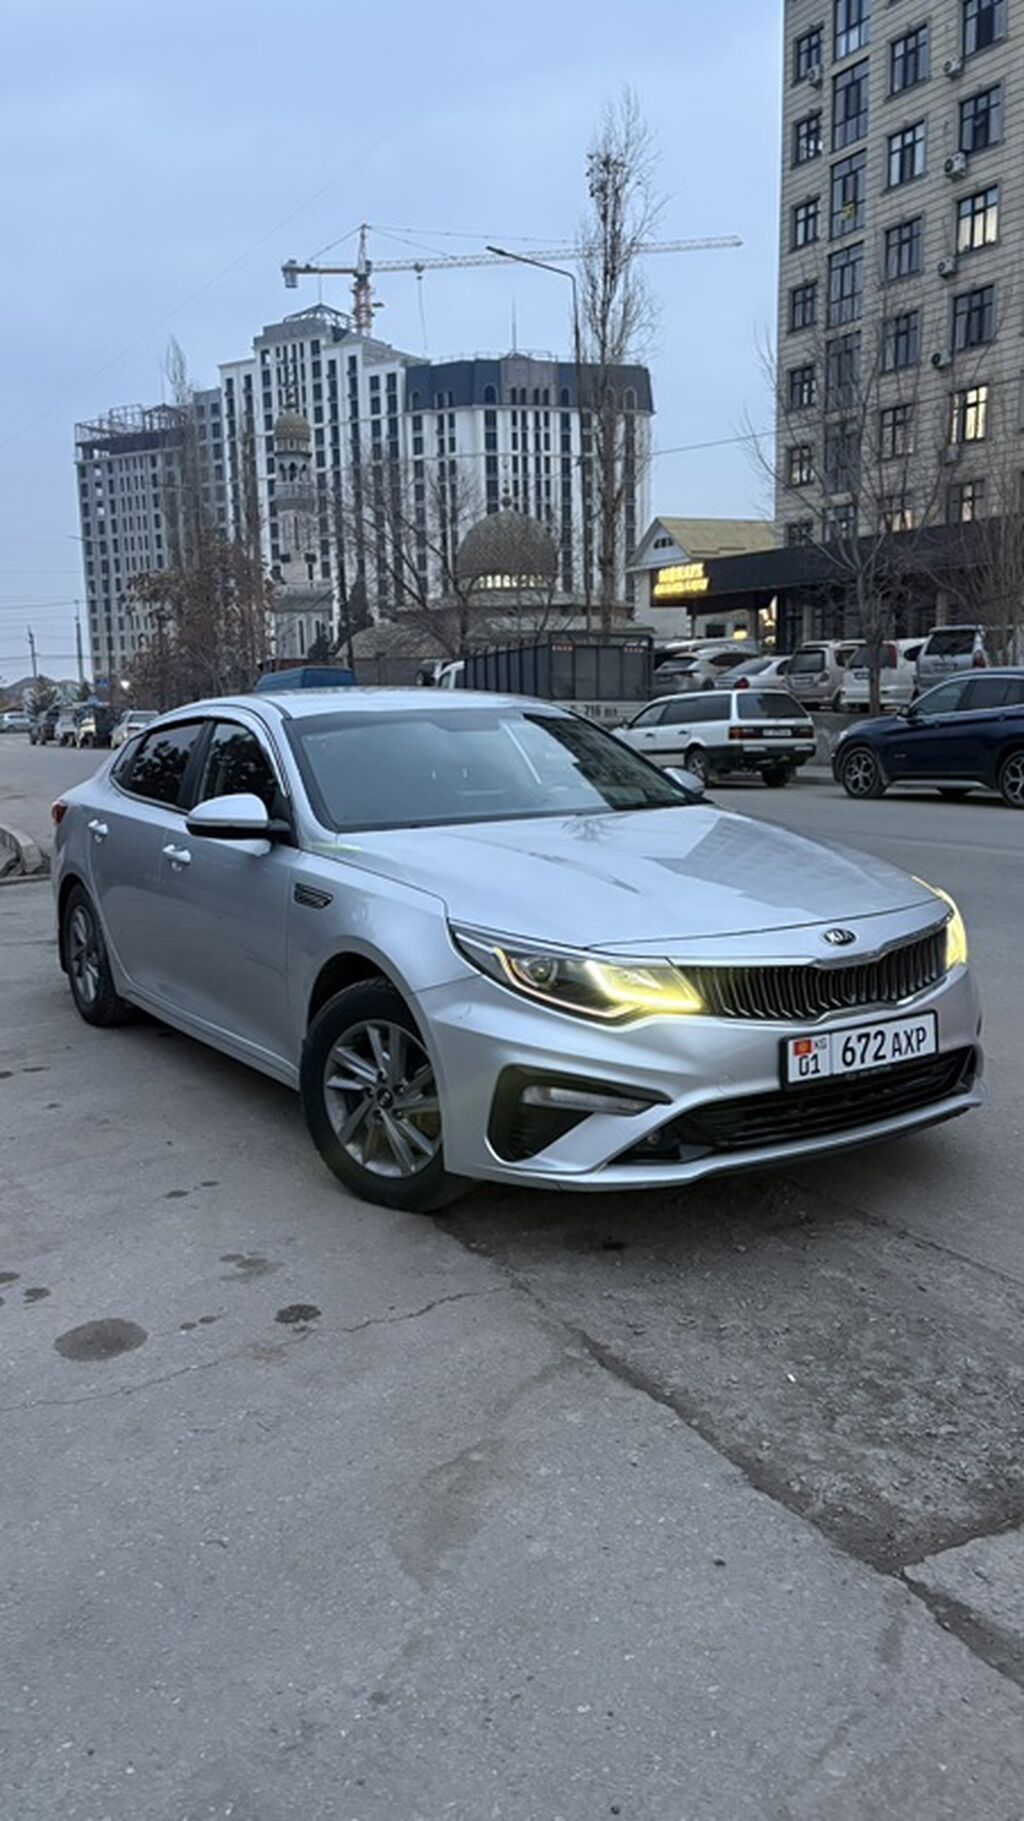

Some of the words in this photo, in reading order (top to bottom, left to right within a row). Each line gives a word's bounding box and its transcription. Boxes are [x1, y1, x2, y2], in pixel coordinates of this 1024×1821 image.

[798, 1054, 820, 1076] 01
[841, 1030, 886, 1067] 672
[891, 1026, 926, 1058] AXP
